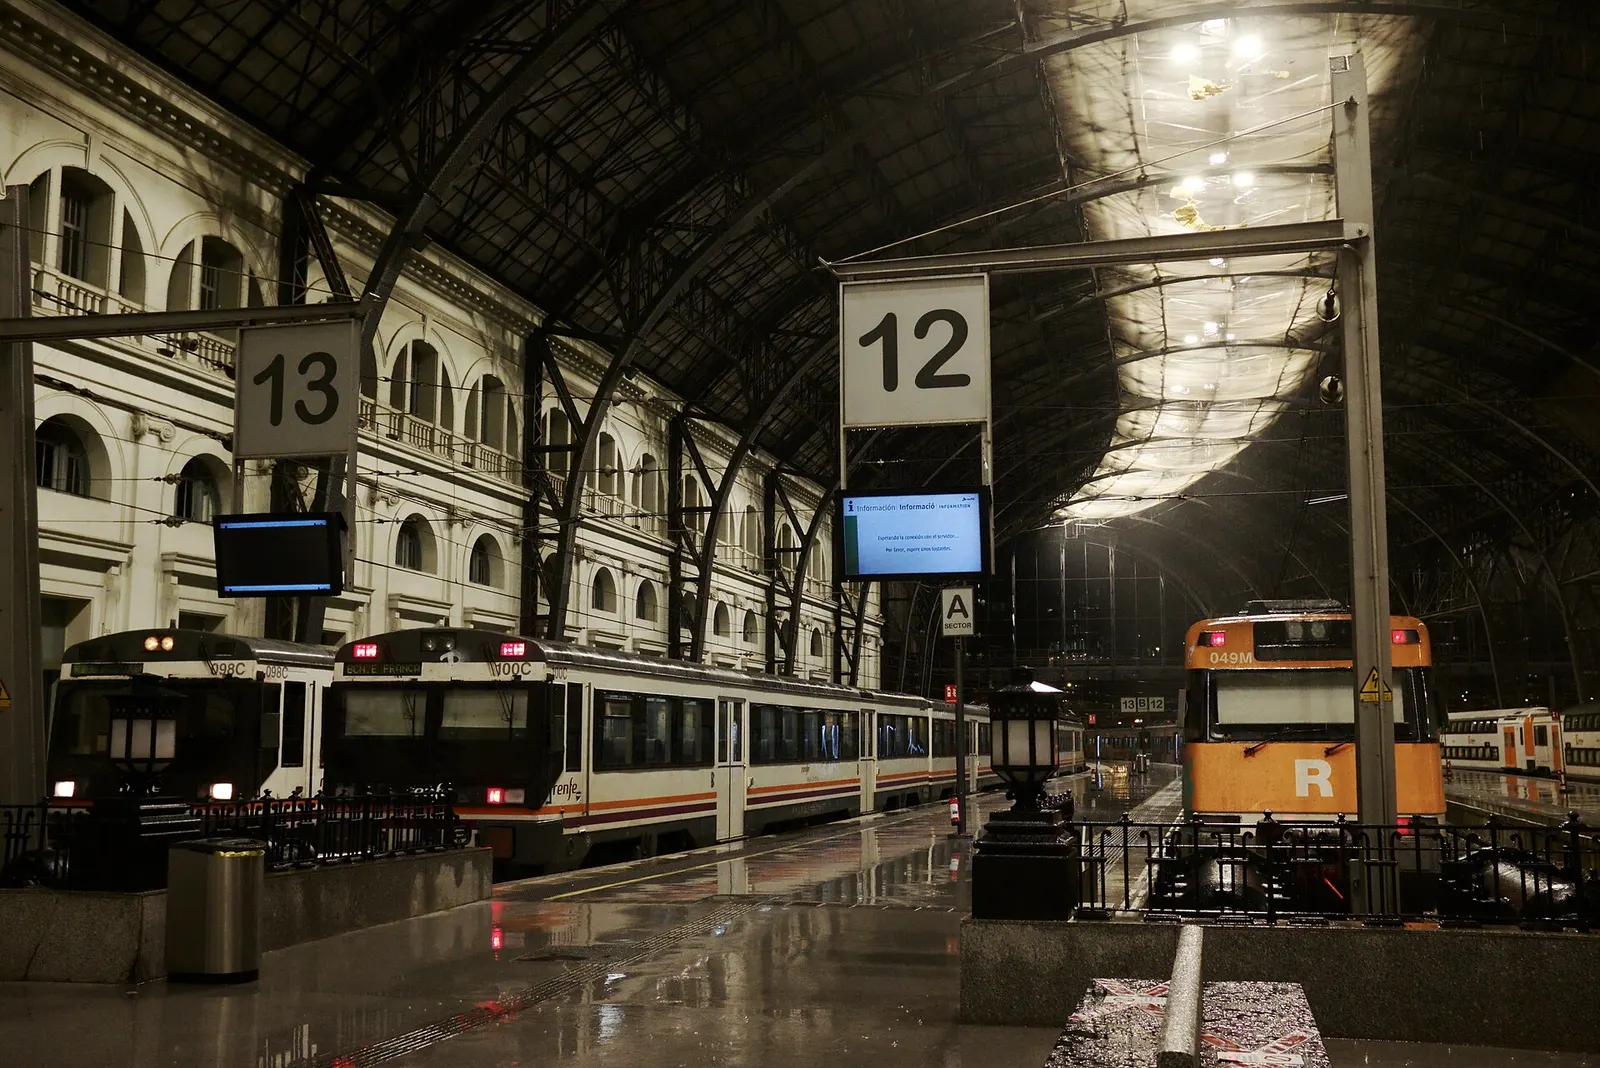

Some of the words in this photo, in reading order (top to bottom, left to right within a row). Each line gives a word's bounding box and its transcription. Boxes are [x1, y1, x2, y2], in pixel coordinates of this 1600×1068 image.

[858, 308, 971, 393] 12
[253, 351, 339, 427] 13
[856, 504, 896, 513] Información
[899, 502, 936, 511] Informació
[947, 594, 969, 619] A
[1209, 651, 1253, 664] 049M
[212, 662, 246, 676] 098C
[265, 665, 289, 679] 098C
[496, 662, 532, 676] 100C
[1122, 699, 1135, 710] 13
[1139, 698, 1146, 708] B
[1150, 699, 1163, 709] 12
[1294, 758, 1334, 797] R
[552, 776, 578, 801] renfe
